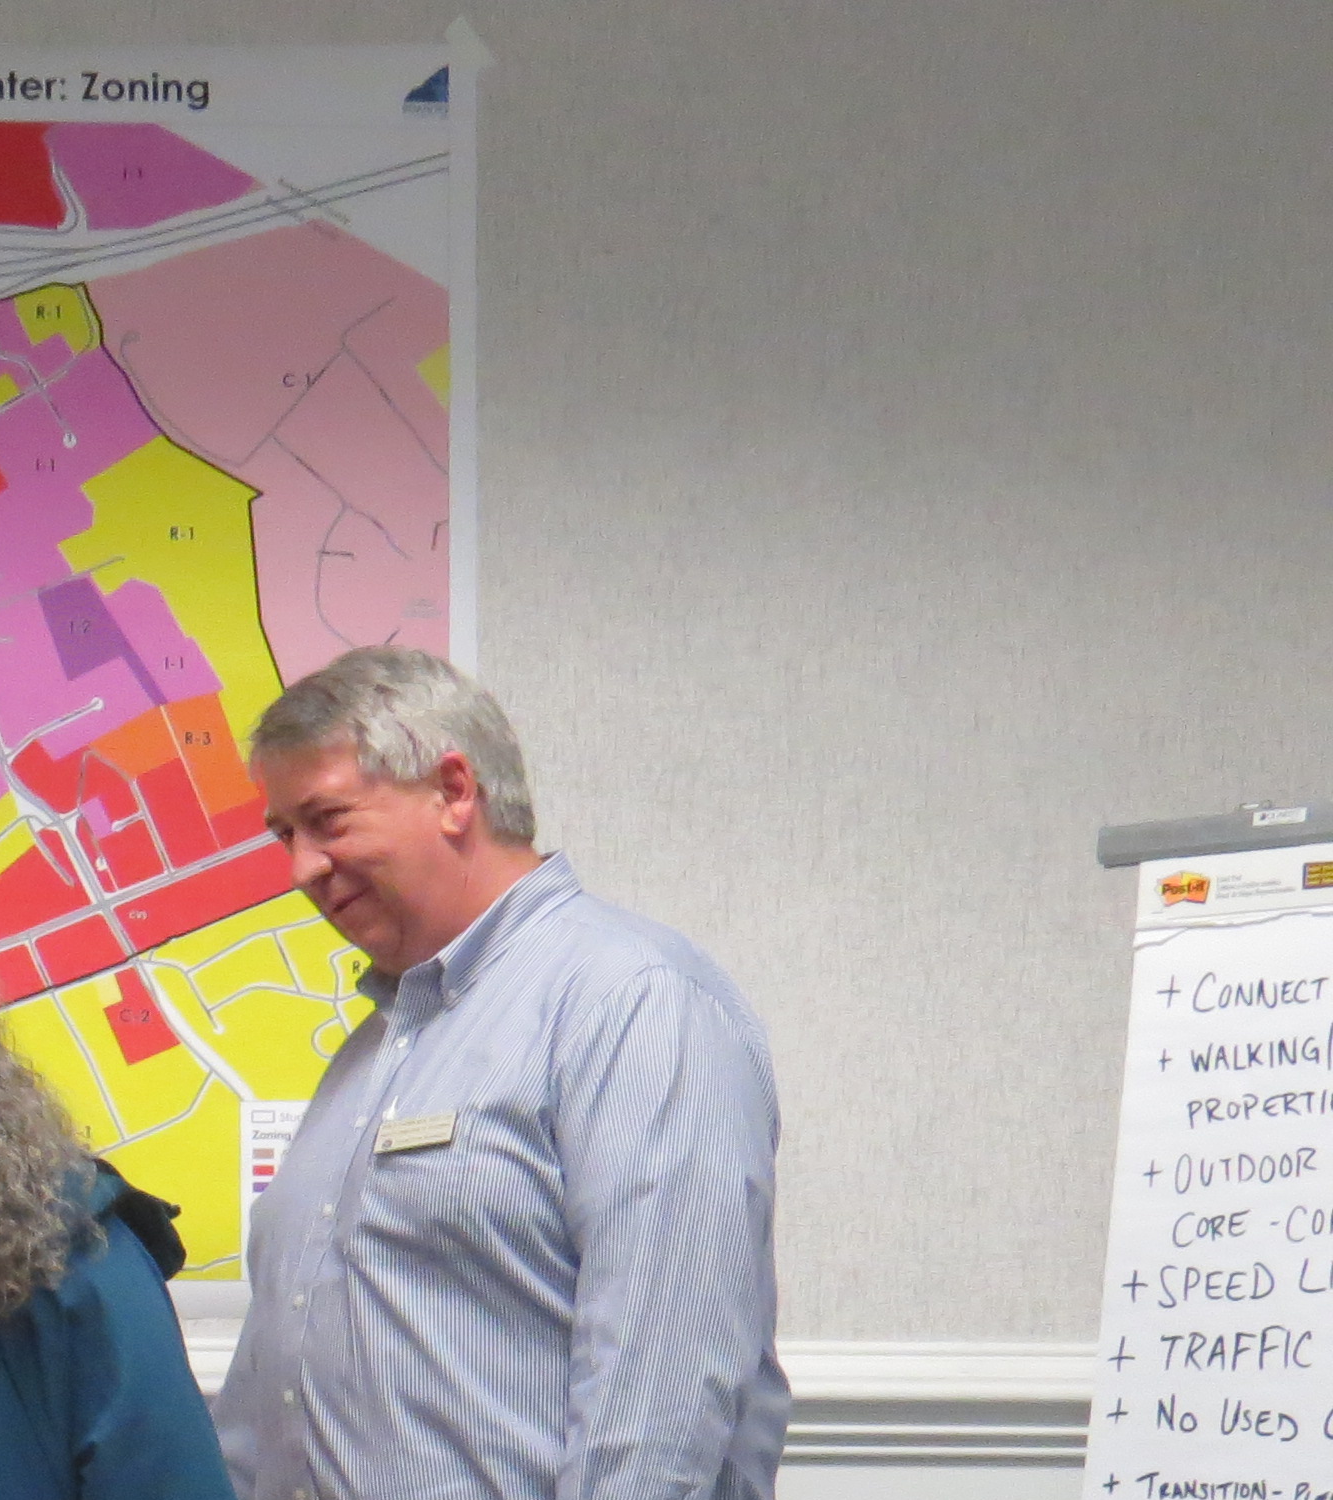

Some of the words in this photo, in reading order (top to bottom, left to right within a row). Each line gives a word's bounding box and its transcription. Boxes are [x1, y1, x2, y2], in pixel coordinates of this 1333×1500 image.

[81, 71, 211, 110] Zoning
[36, 305, 62, 319] R-1
[170, 526, 196, 540] R-1
[164, 656, 184, 670] I-1
[185, 731, 211, 746] R-3
[1192, 971, 1330, 1013] CONNECT
[119, 1009, 151, 1023] C-2
[1188, 1089, 1333, 1130] PROPERTI
[252, 1129, 292, 1142] Zoning
[1174, 1146, 1317, 1194] OUTDOOR
[1172, 1208, 1252, 1248] CORE
[1157, 1261, 1276, 1309] SPEED
[1159, 1324, 1314, 1372] TRAFFIC
[1219, 1396, 1299, 1442] USED
